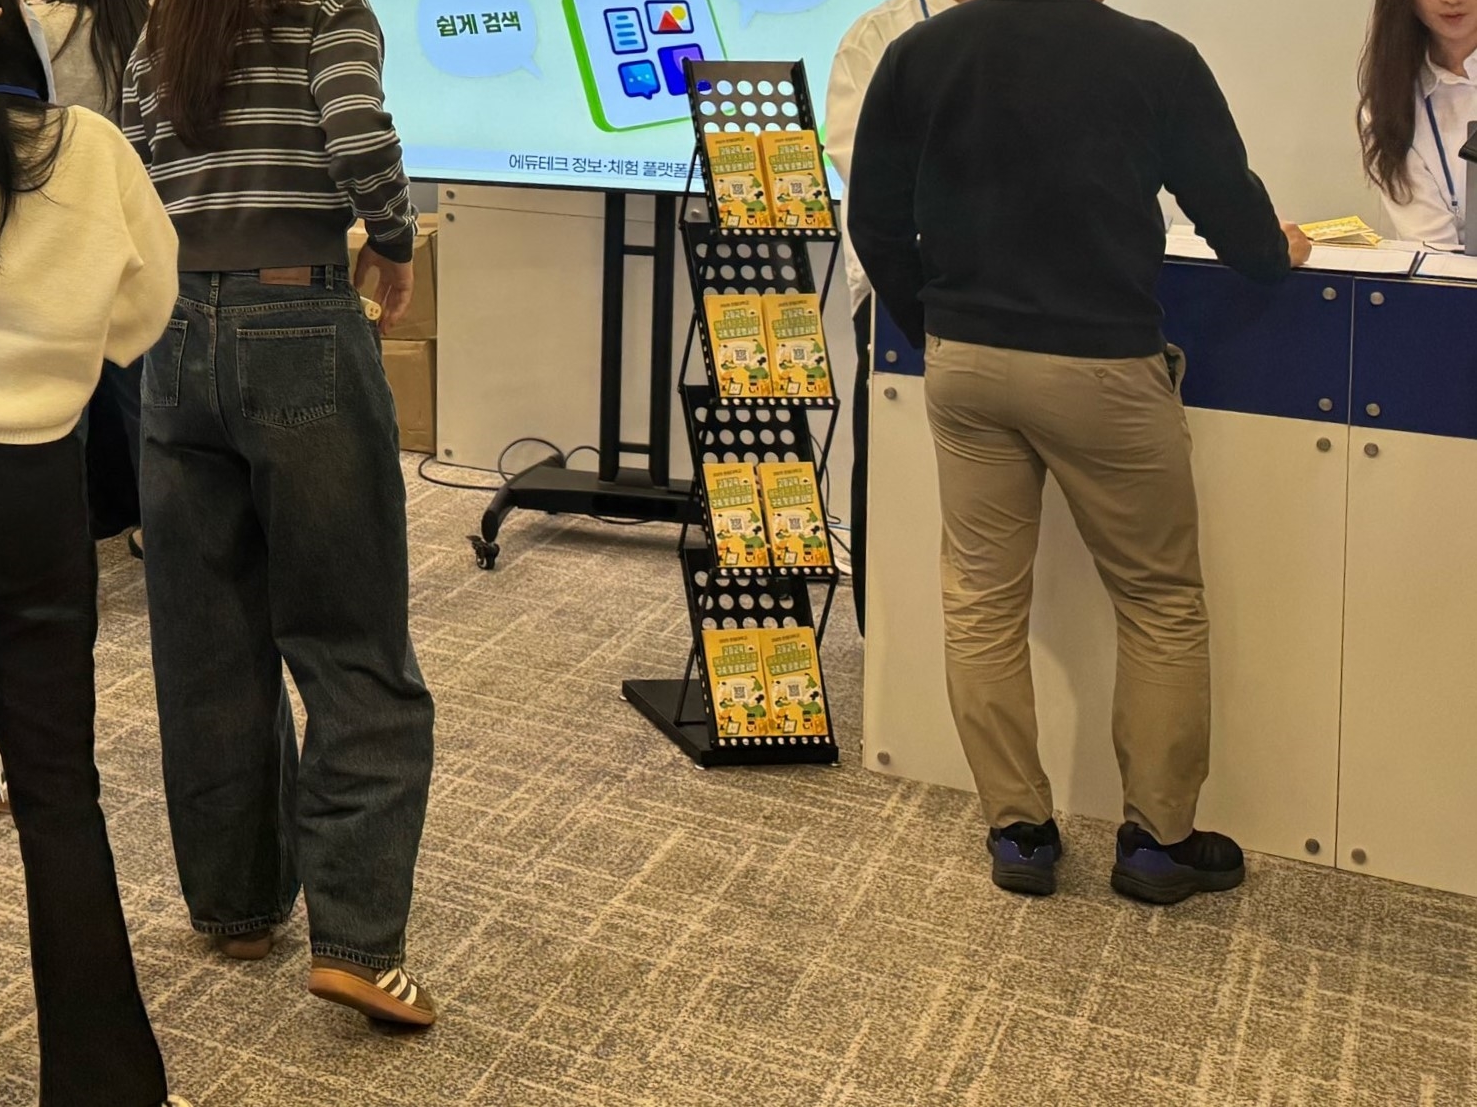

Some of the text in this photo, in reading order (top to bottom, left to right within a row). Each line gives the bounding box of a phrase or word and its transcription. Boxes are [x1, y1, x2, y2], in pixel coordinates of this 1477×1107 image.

[436, 11, 522, 38] 쉽게 검색
[508, 154, 569, 172] 에듀테크
